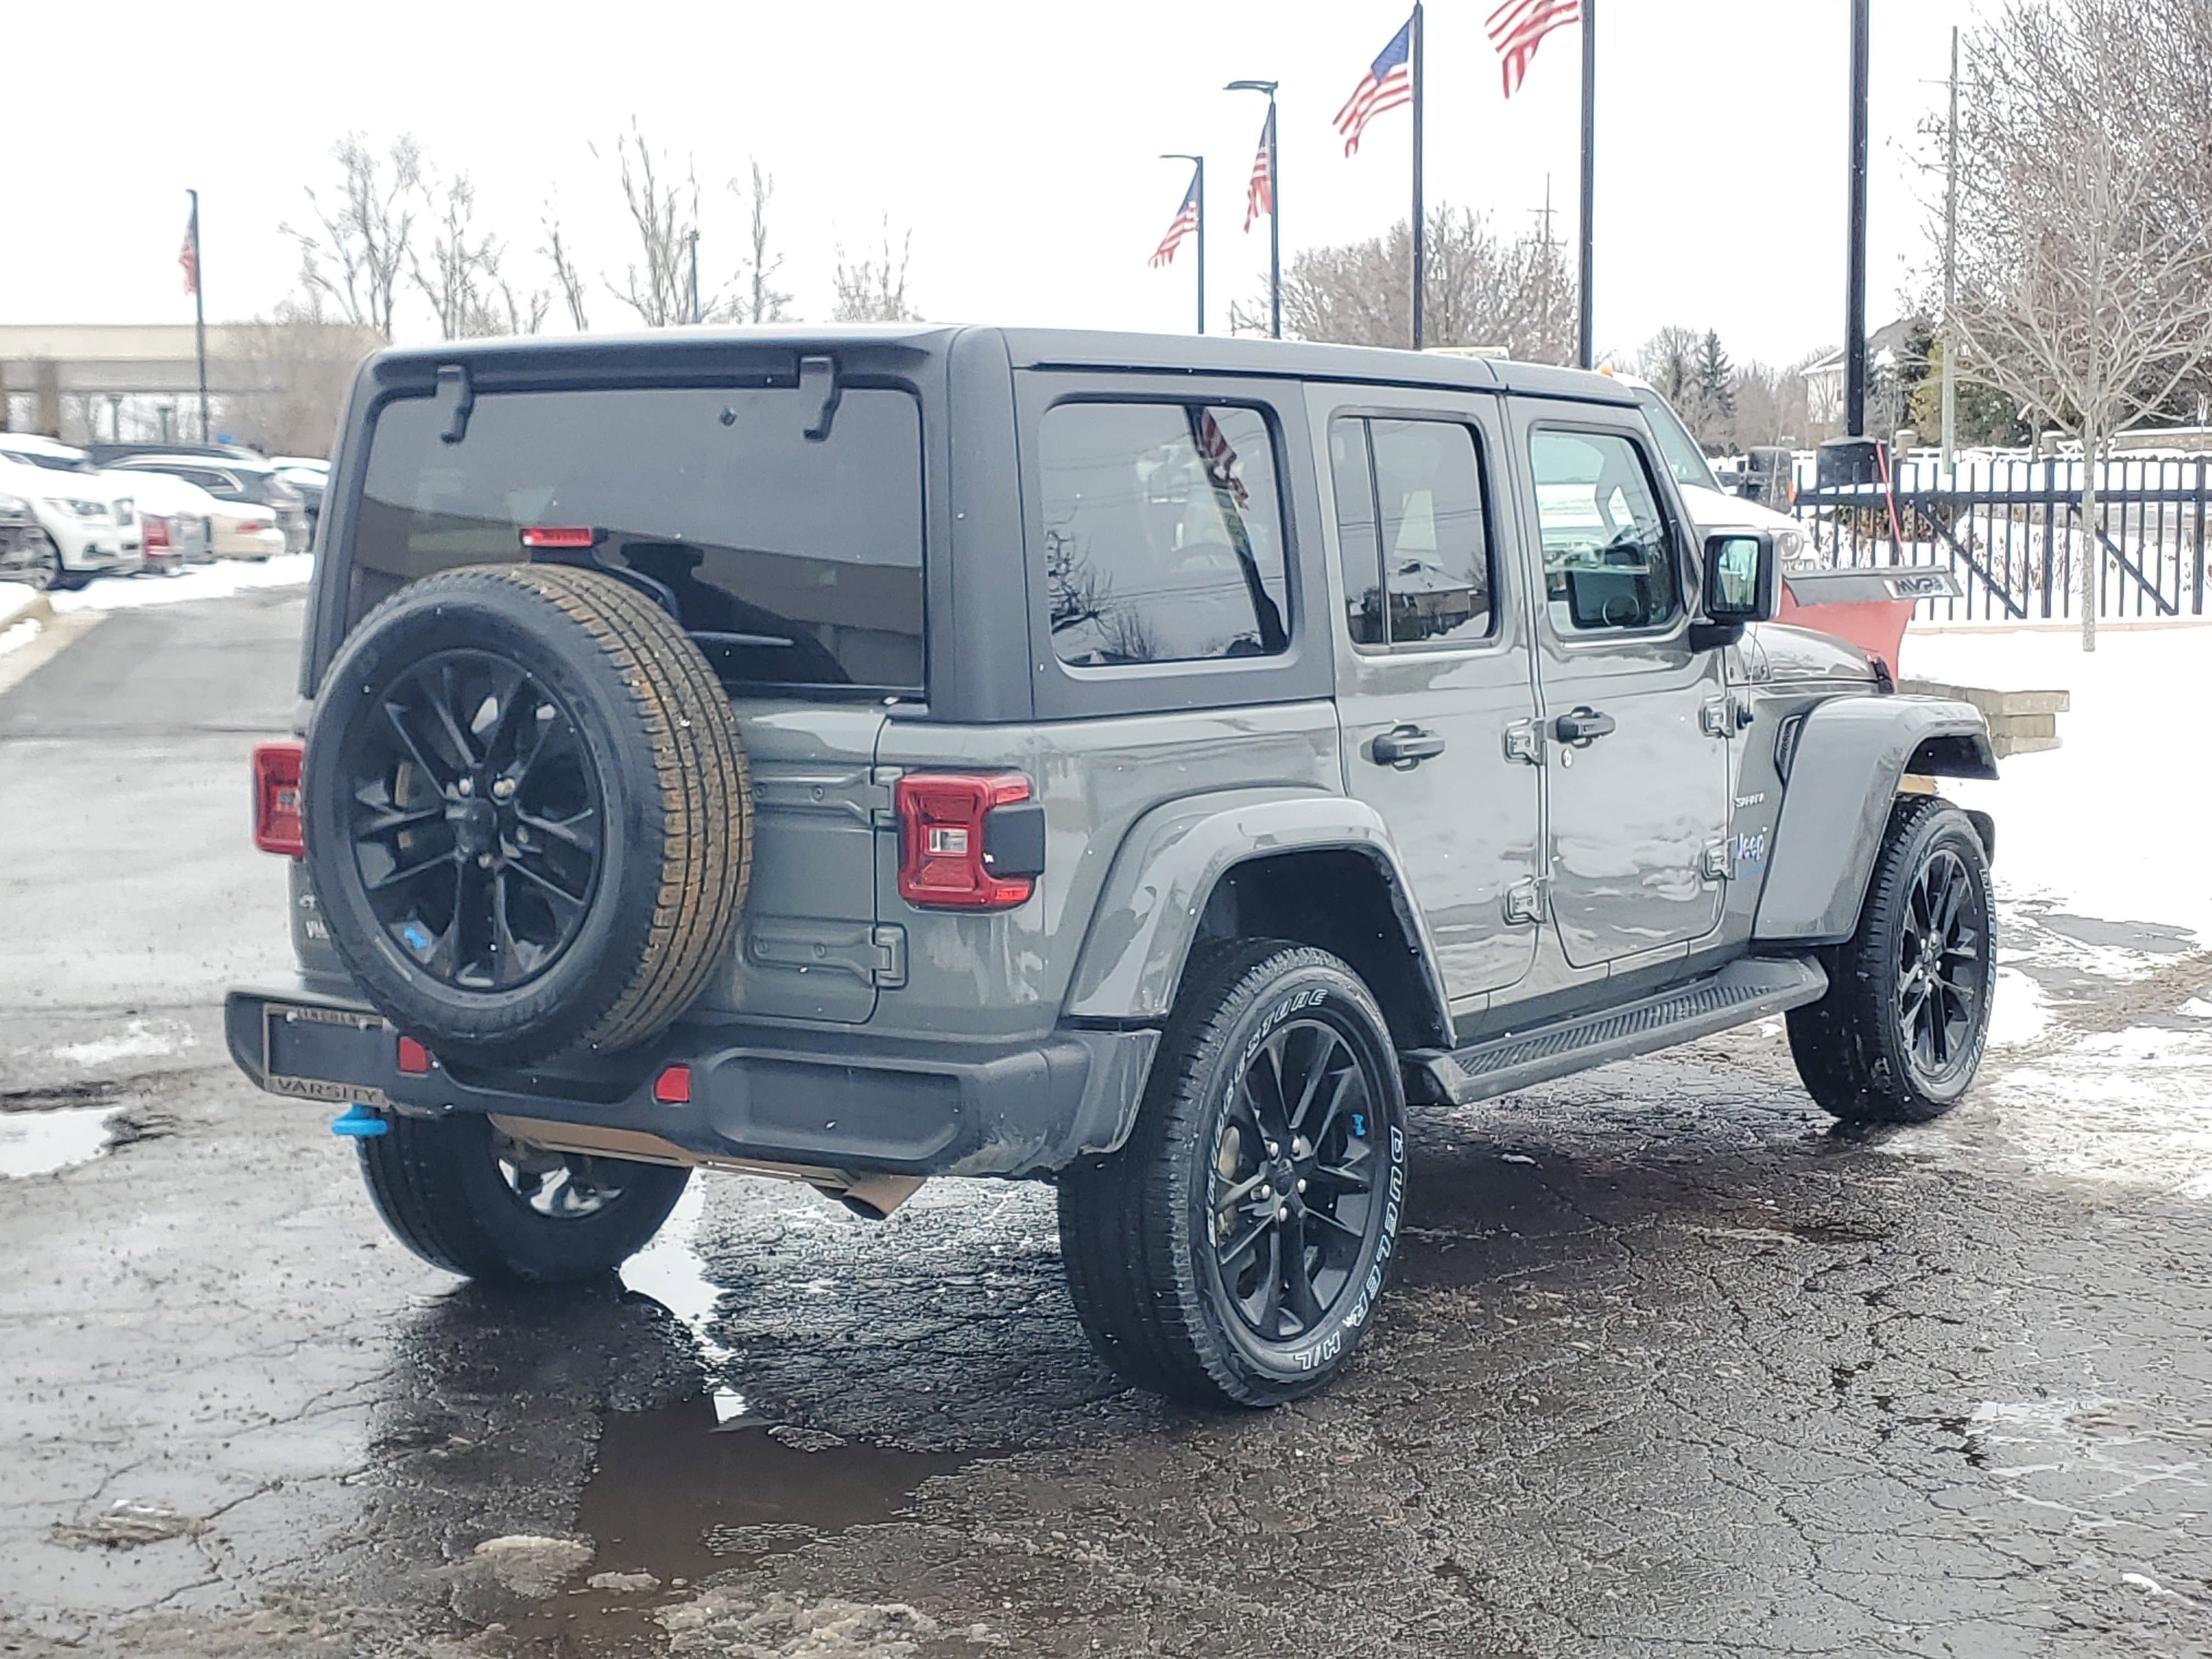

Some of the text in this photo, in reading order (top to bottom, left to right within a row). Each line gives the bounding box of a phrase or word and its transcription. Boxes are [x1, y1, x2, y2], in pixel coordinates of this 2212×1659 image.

[278, 1078, 376, 1103] VARSITY
[1206, 988, 1328, 1249] BRIDGESTONE
[1295, 1125, 1404, 1370] DUELER H/L
